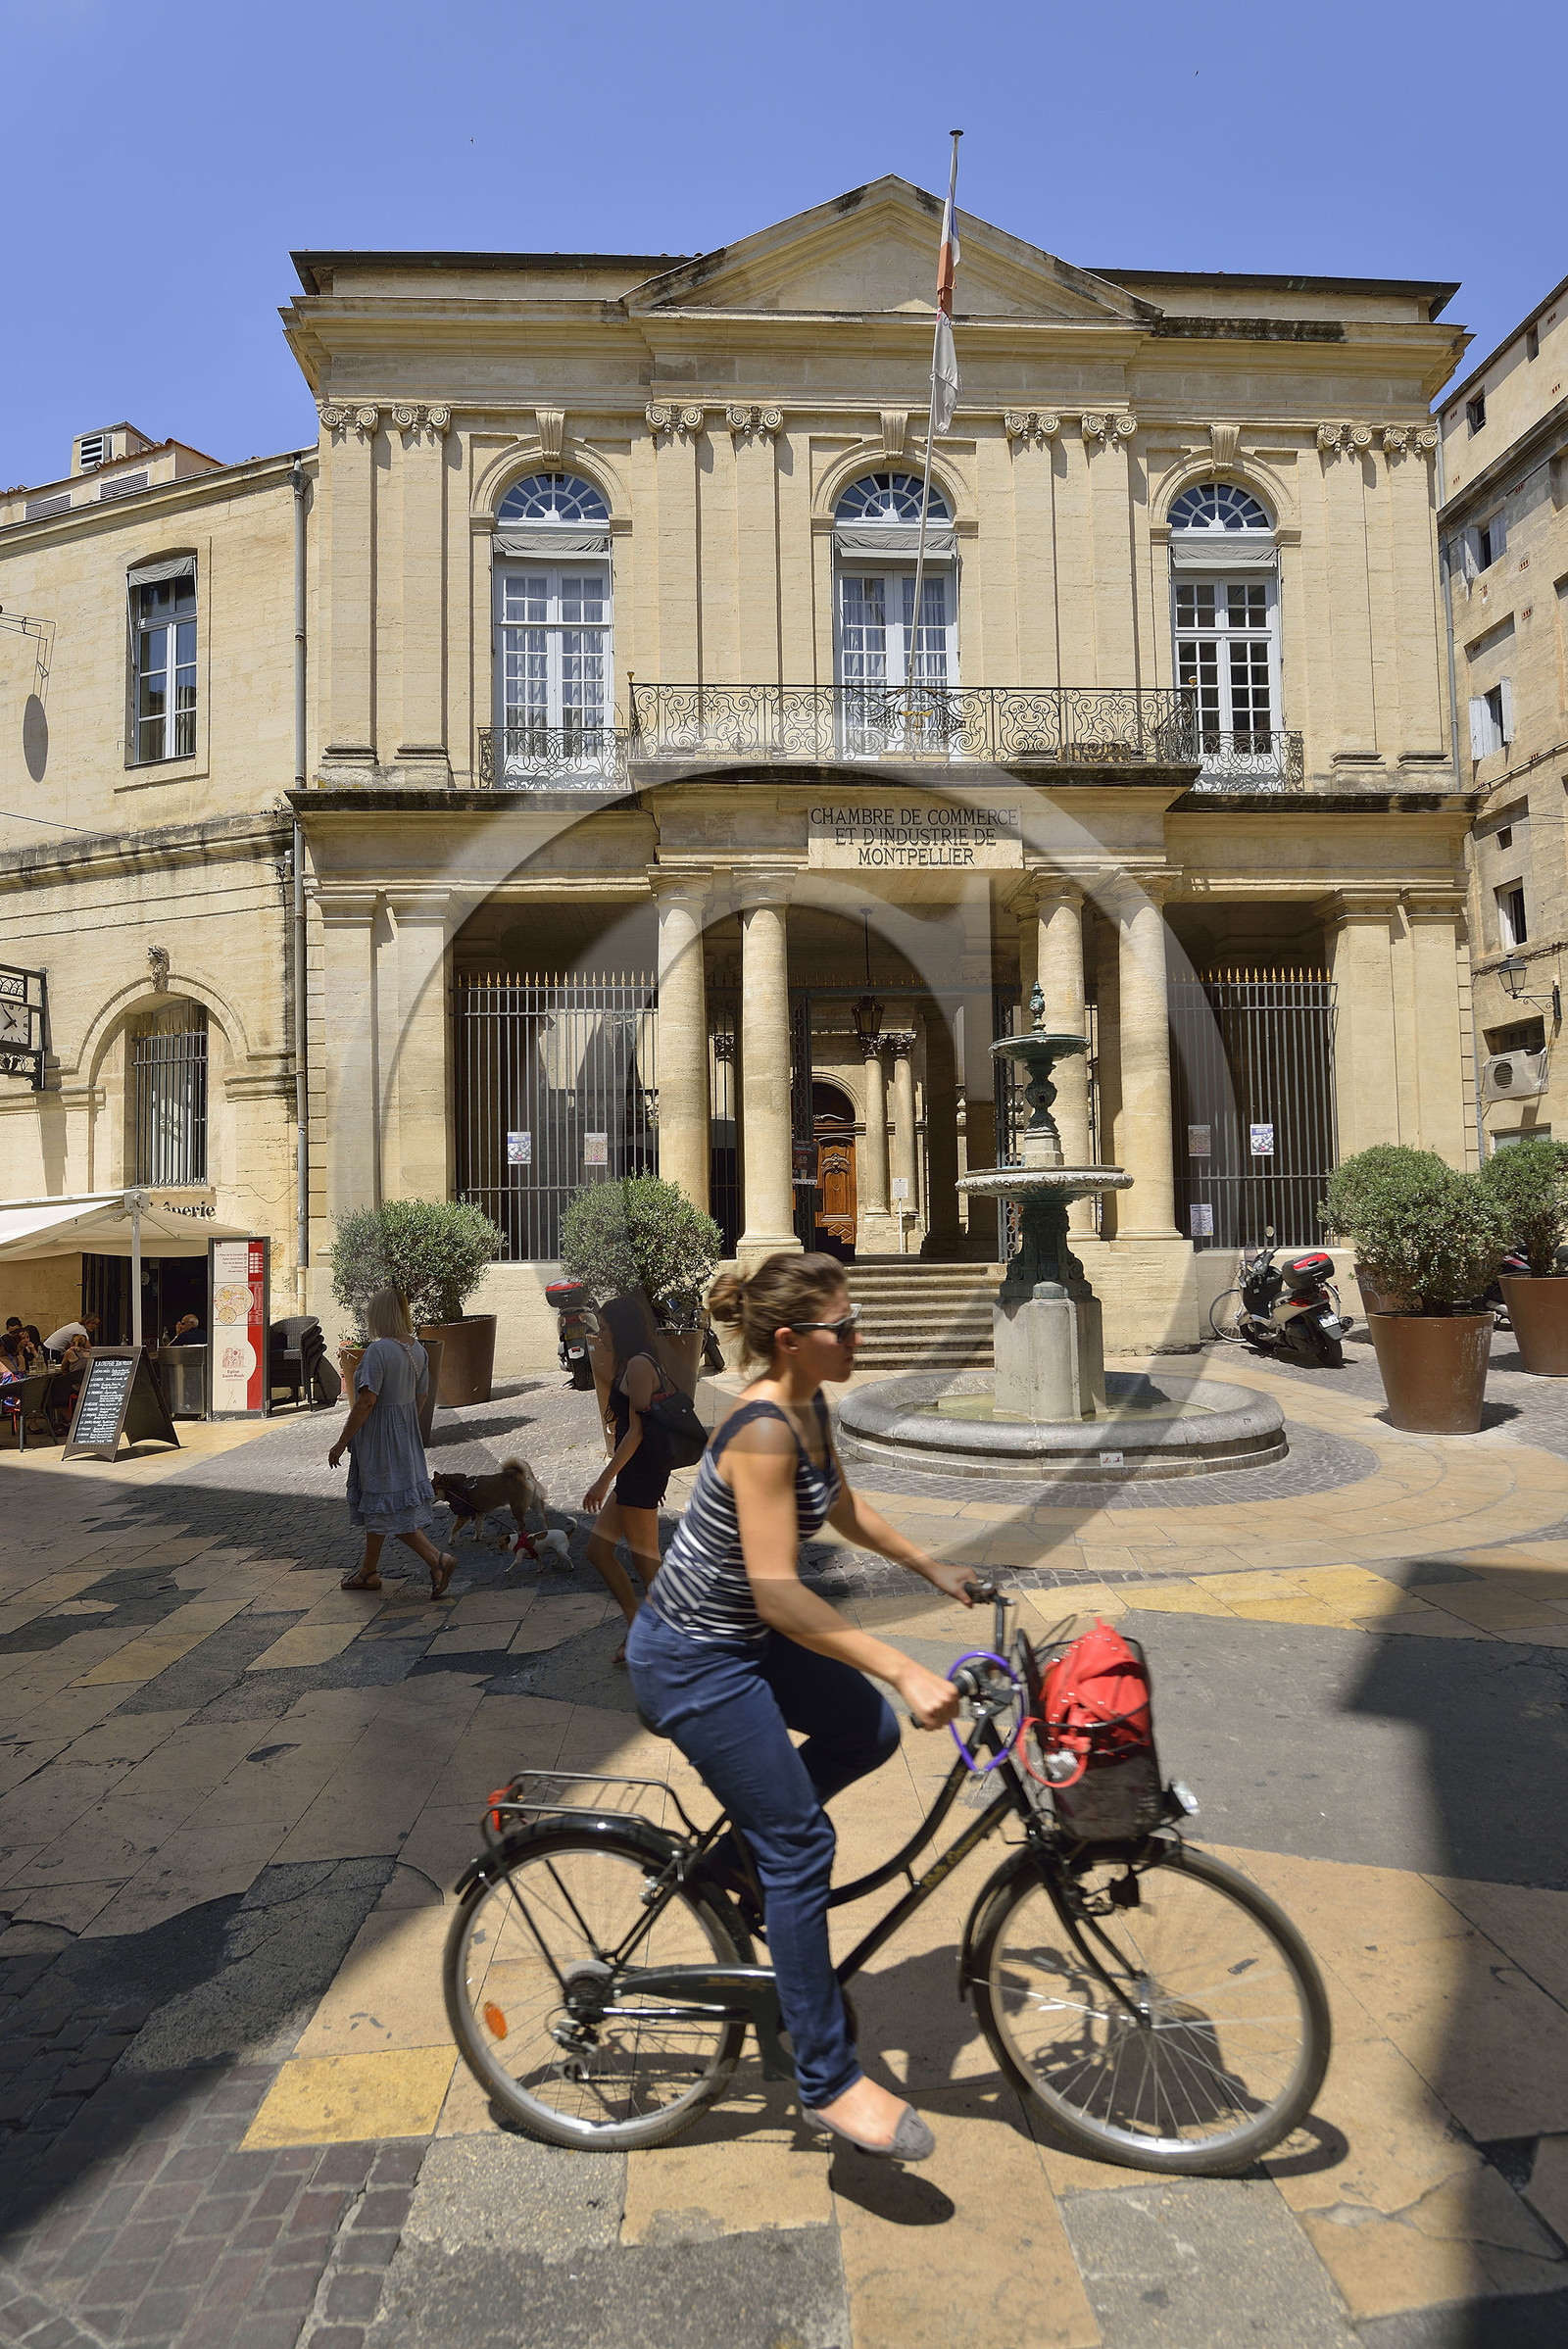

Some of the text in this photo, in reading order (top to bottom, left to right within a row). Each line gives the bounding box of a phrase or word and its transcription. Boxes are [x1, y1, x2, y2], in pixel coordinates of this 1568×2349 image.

[810, 807, 1018, 826] CHAMBRE DE COMMERCE
[835, 828, 997, 846] ET D'INDUSTRIE DE
[858, 848, 975, 865] MONTPELLIER
